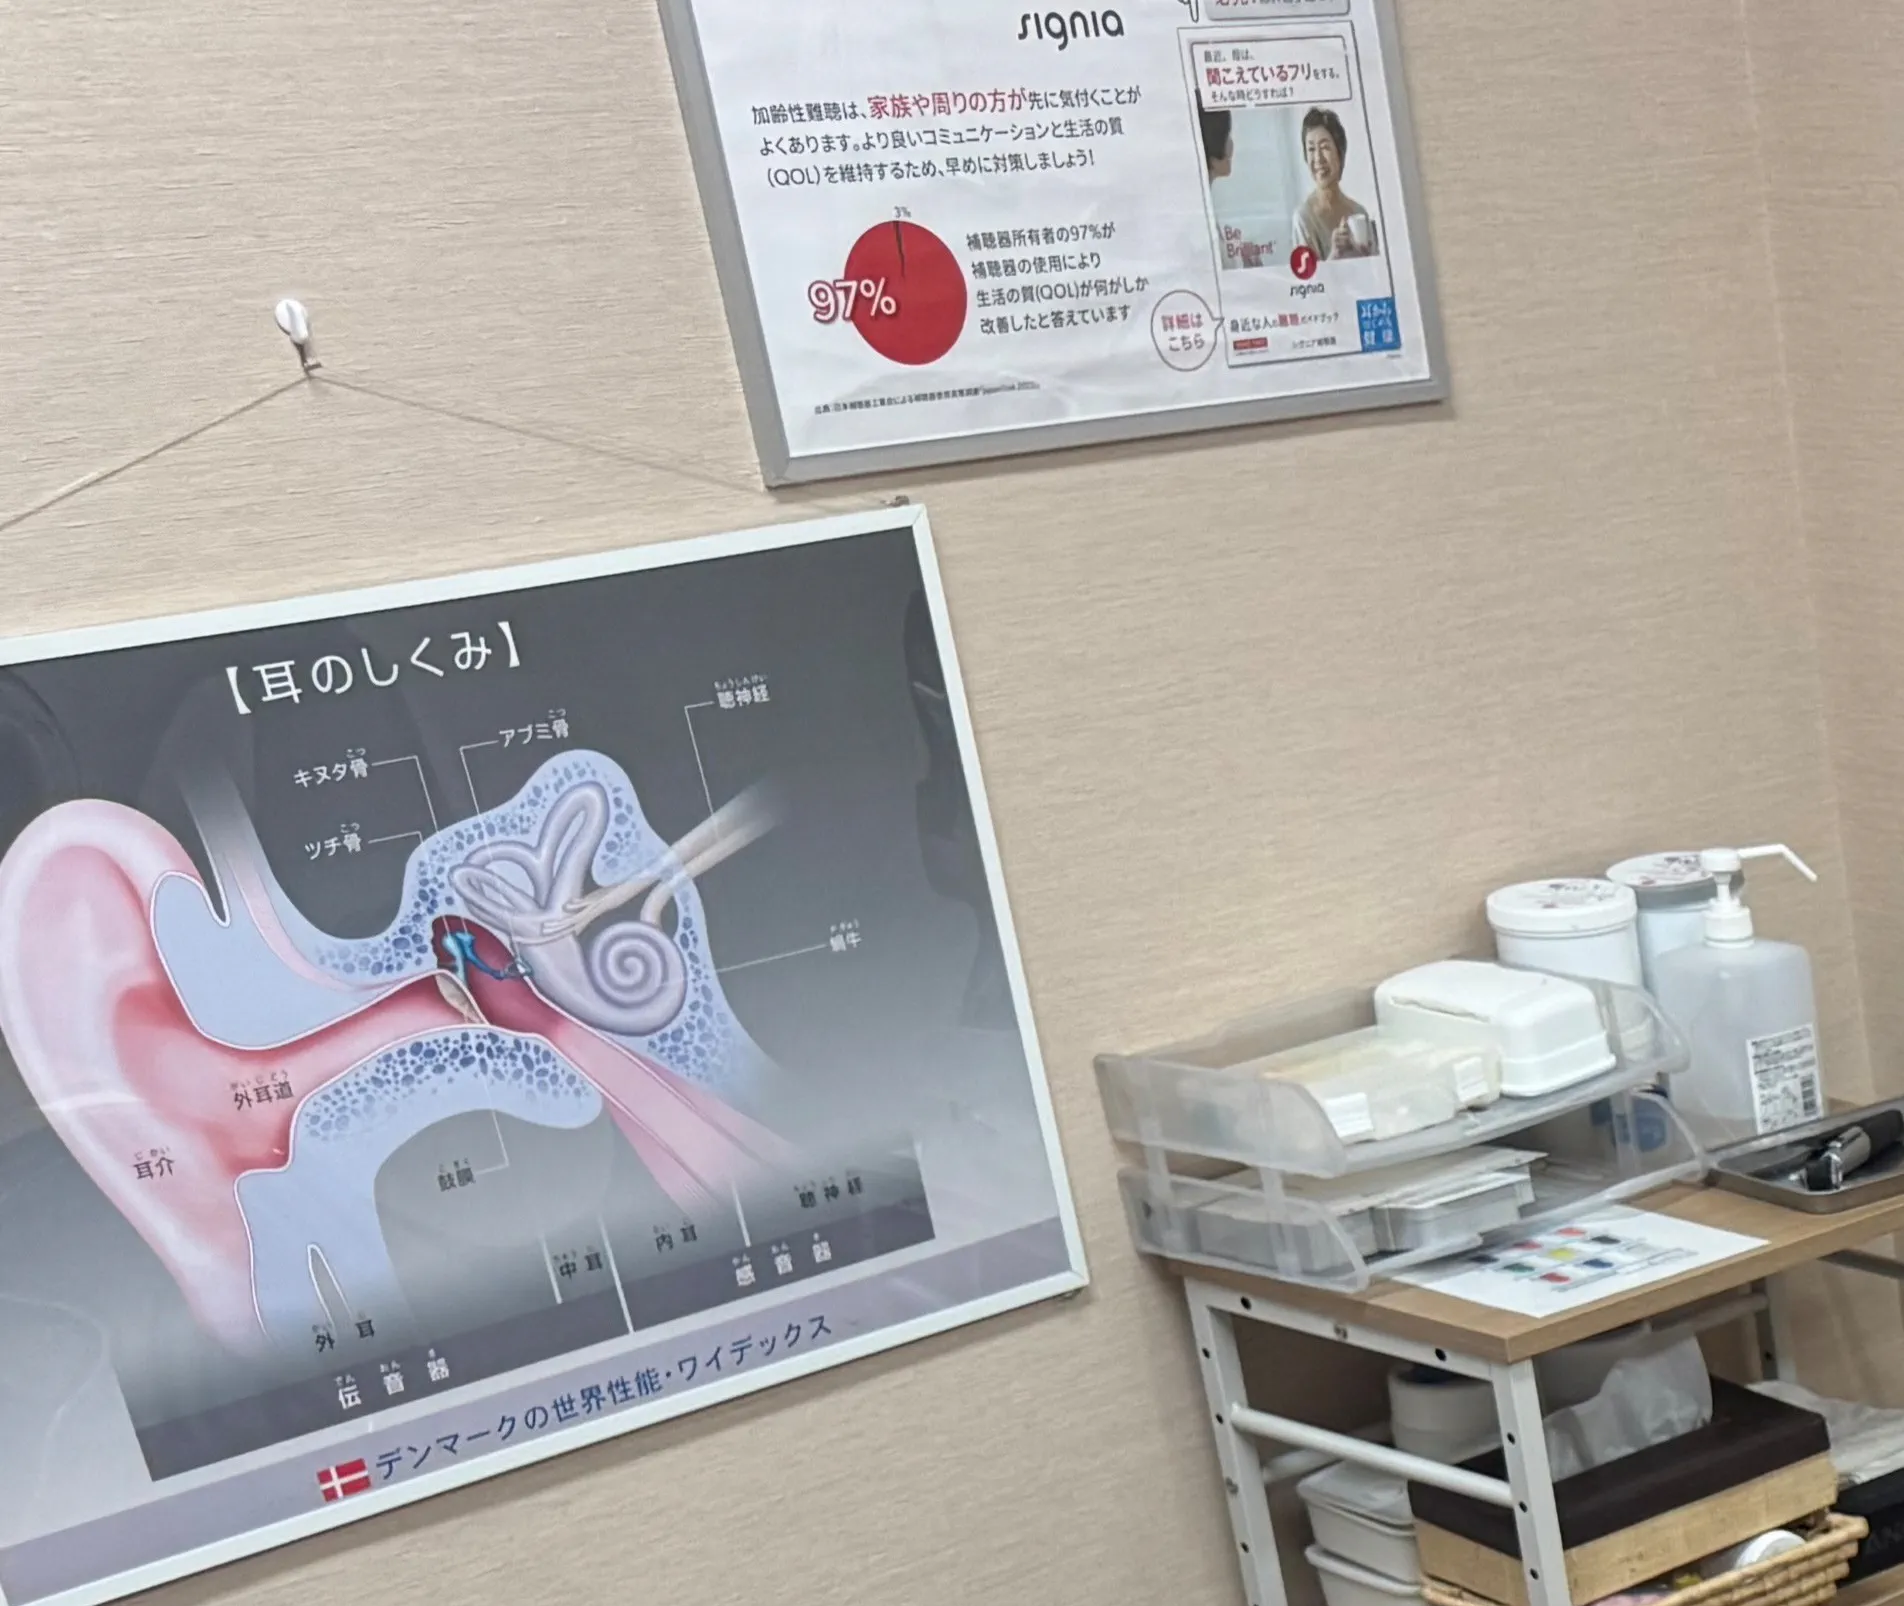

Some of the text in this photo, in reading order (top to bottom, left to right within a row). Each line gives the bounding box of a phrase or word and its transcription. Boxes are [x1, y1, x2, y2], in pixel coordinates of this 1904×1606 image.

[1018, 9, 1124, 51] signia
[752, 84, 1141, 125] 加齢性難聴は、家族や周りの方が先に気付くことが
[759, 117, 1124, 156] よくあります。より良いコミュニケーションと生活の質
[966, 222, 1116, 251] 補聴器所有者の97%が
[971, 251, 1101, 279] 補聴器の使用により
[808, 277, 897, 323] 97%
[980, 305, 1132, 335] 改善したと答えています
[1168, 333, 1206, 352] こちら
[225, 621, 520, 716] 【耳のしくみ】
[499, 717, 569, 747] アブミ骨
[293, 757, 369, 788] キヌタ骨
[304, 832, 362, 860] ツチ骨
[233, 1081, 295, 1111] 外耳道
[133, 1156, 175, 1180] 耳介
[656, 1223, 698, 1253] 内耳
[559, 1251, 603, 1280] 中耳
[315, 1319, 375, 1352] 外耳
[376, 1314, 832, 1480] デンマークの世界性能・ワイデックス
